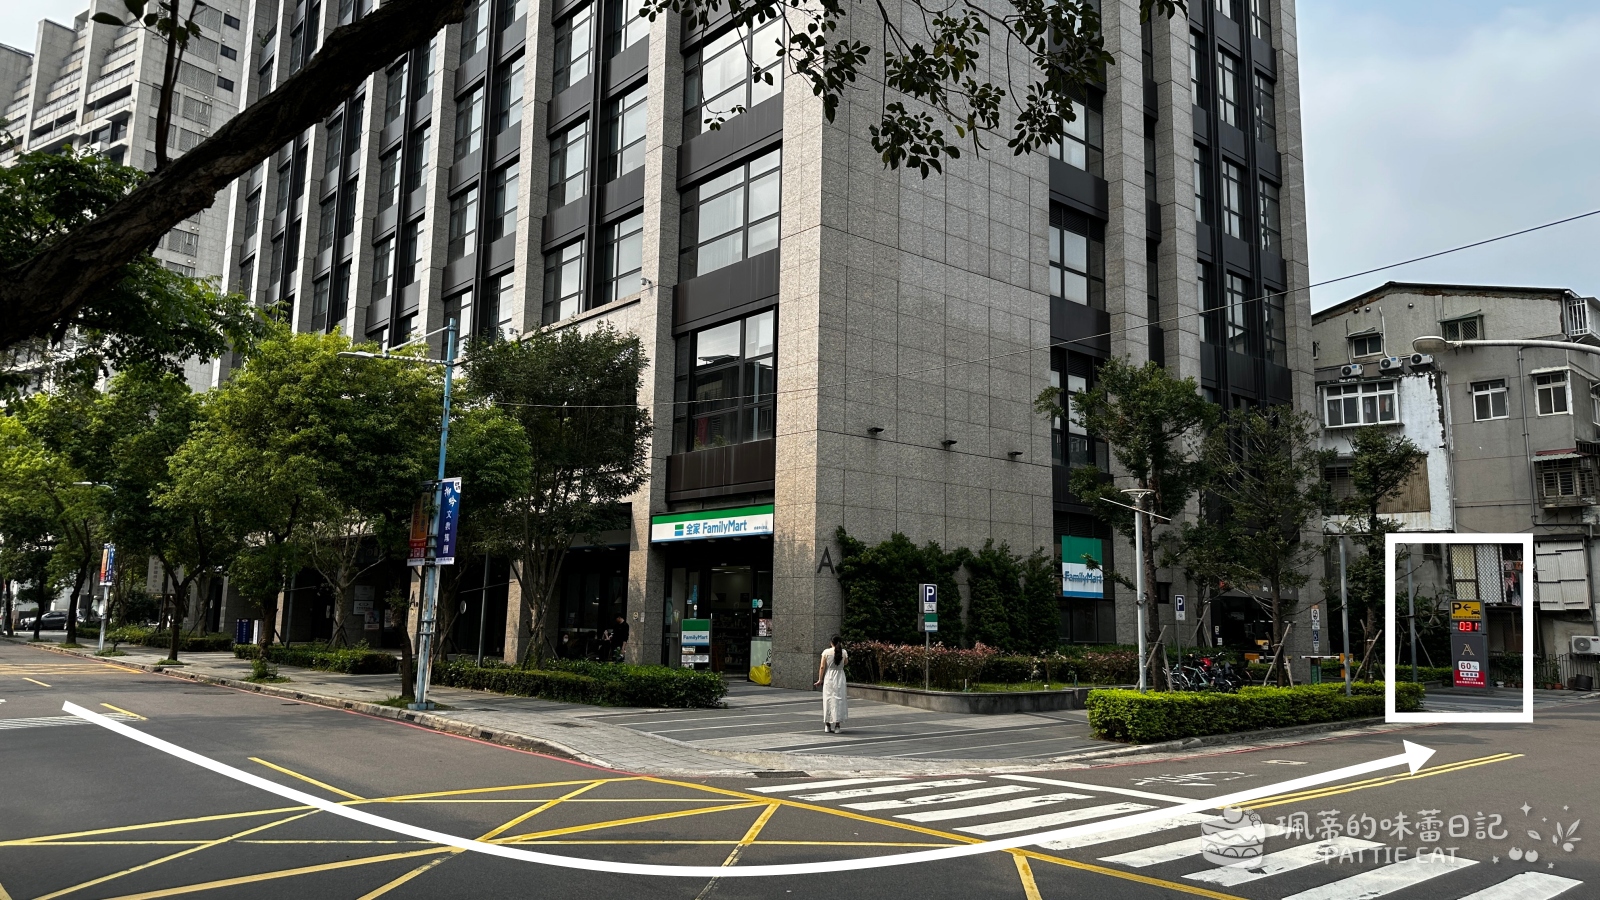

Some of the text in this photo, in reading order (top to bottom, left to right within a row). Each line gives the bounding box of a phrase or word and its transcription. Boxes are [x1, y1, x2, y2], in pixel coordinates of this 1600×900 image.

[686, 519, 748, 535] 全家 FamilyMart
[817, 546, 835, 574] A
[1064, 570, 1103, 586] FamilyMart
[926, 586, 935, 602] P
[1176, 597, 1183, 610] P
[1452, 603, 1461, 614] P
